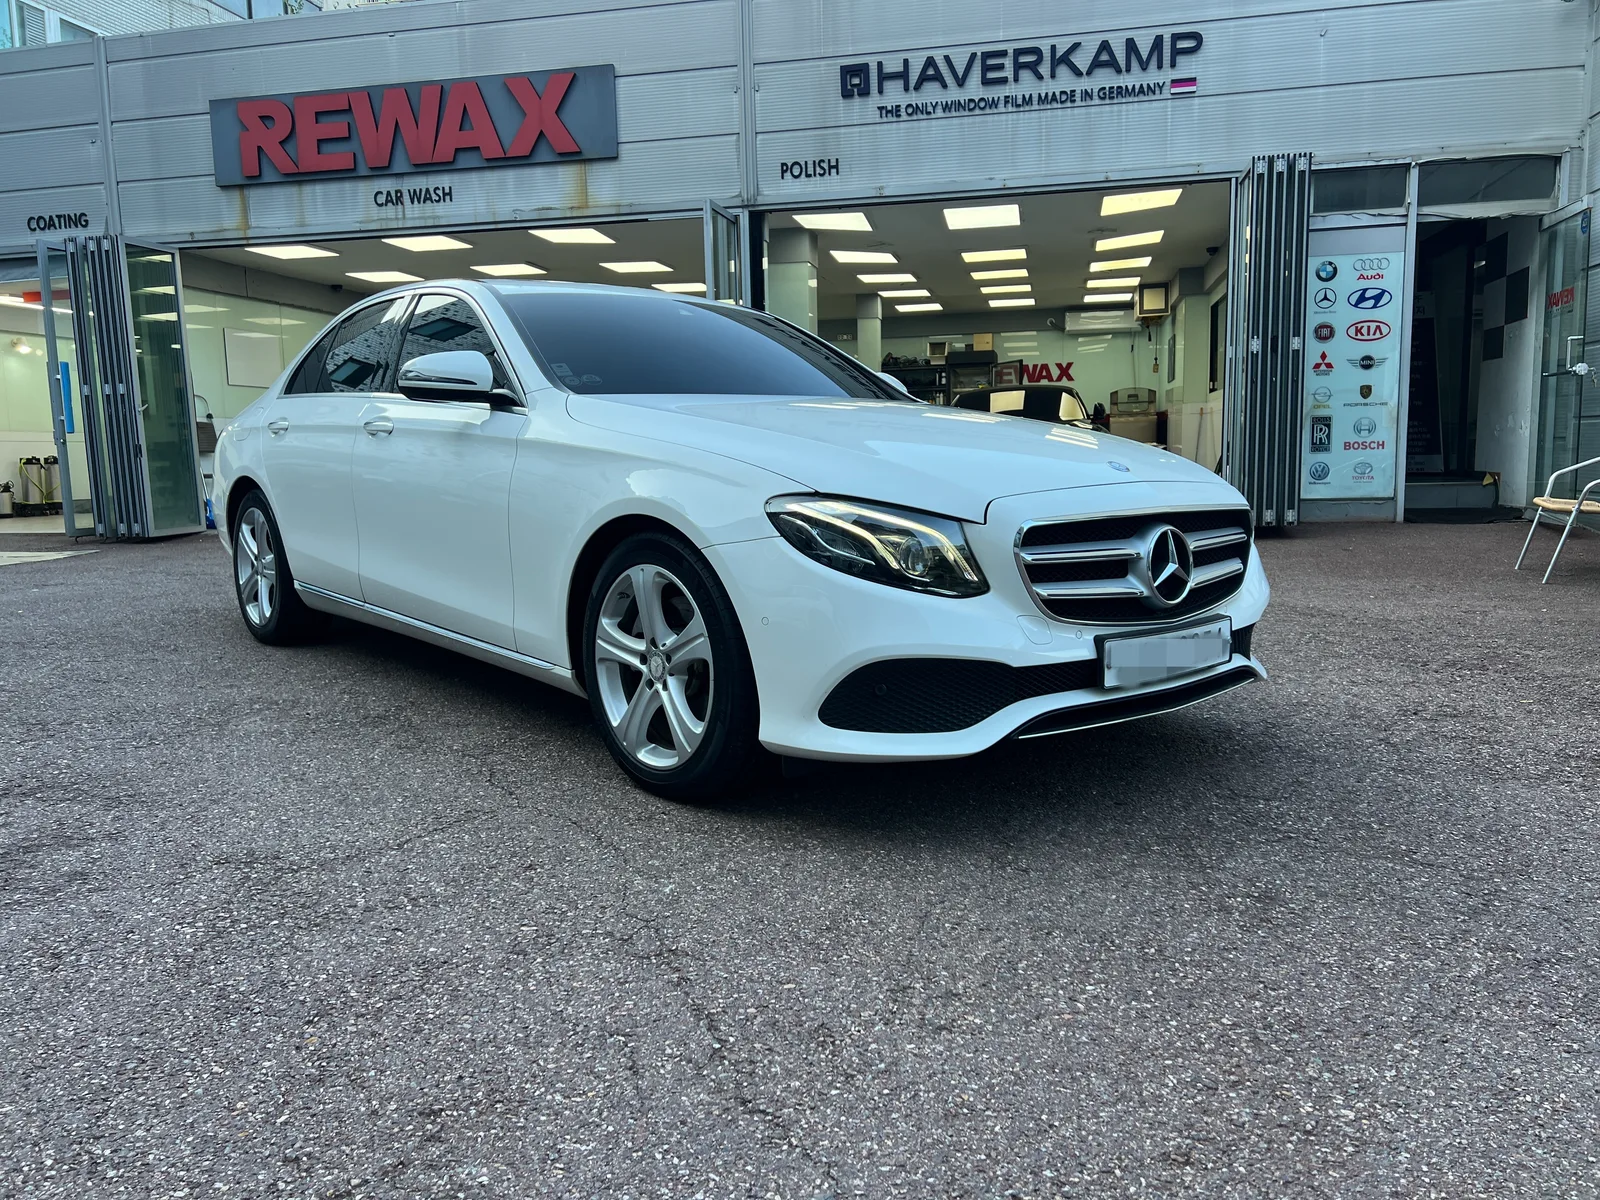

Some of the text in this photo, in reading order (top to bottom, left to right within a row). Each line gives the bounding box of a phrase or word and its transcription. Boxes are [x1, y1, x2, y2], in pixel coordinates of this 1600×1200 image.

[877, 31, 1203, 94] HAVERKAMP
[877, 81, 1166, 118] THE ONLY WINDOW FILM MADE IN GERMANY
[237, 72, 581, 177] REWAX
[780, 158, 839, 180] POLISH
[373, 186, 453, 207] CAR WASH
[27, 212, 89, 232] COATING
[1356, 273, 1384, 281] Audi
[1318, 327, 1331, 337] FIAT
[1355, 325, 1384, 337] KIA
[1343, 440, 1385, 451] BOSCH
